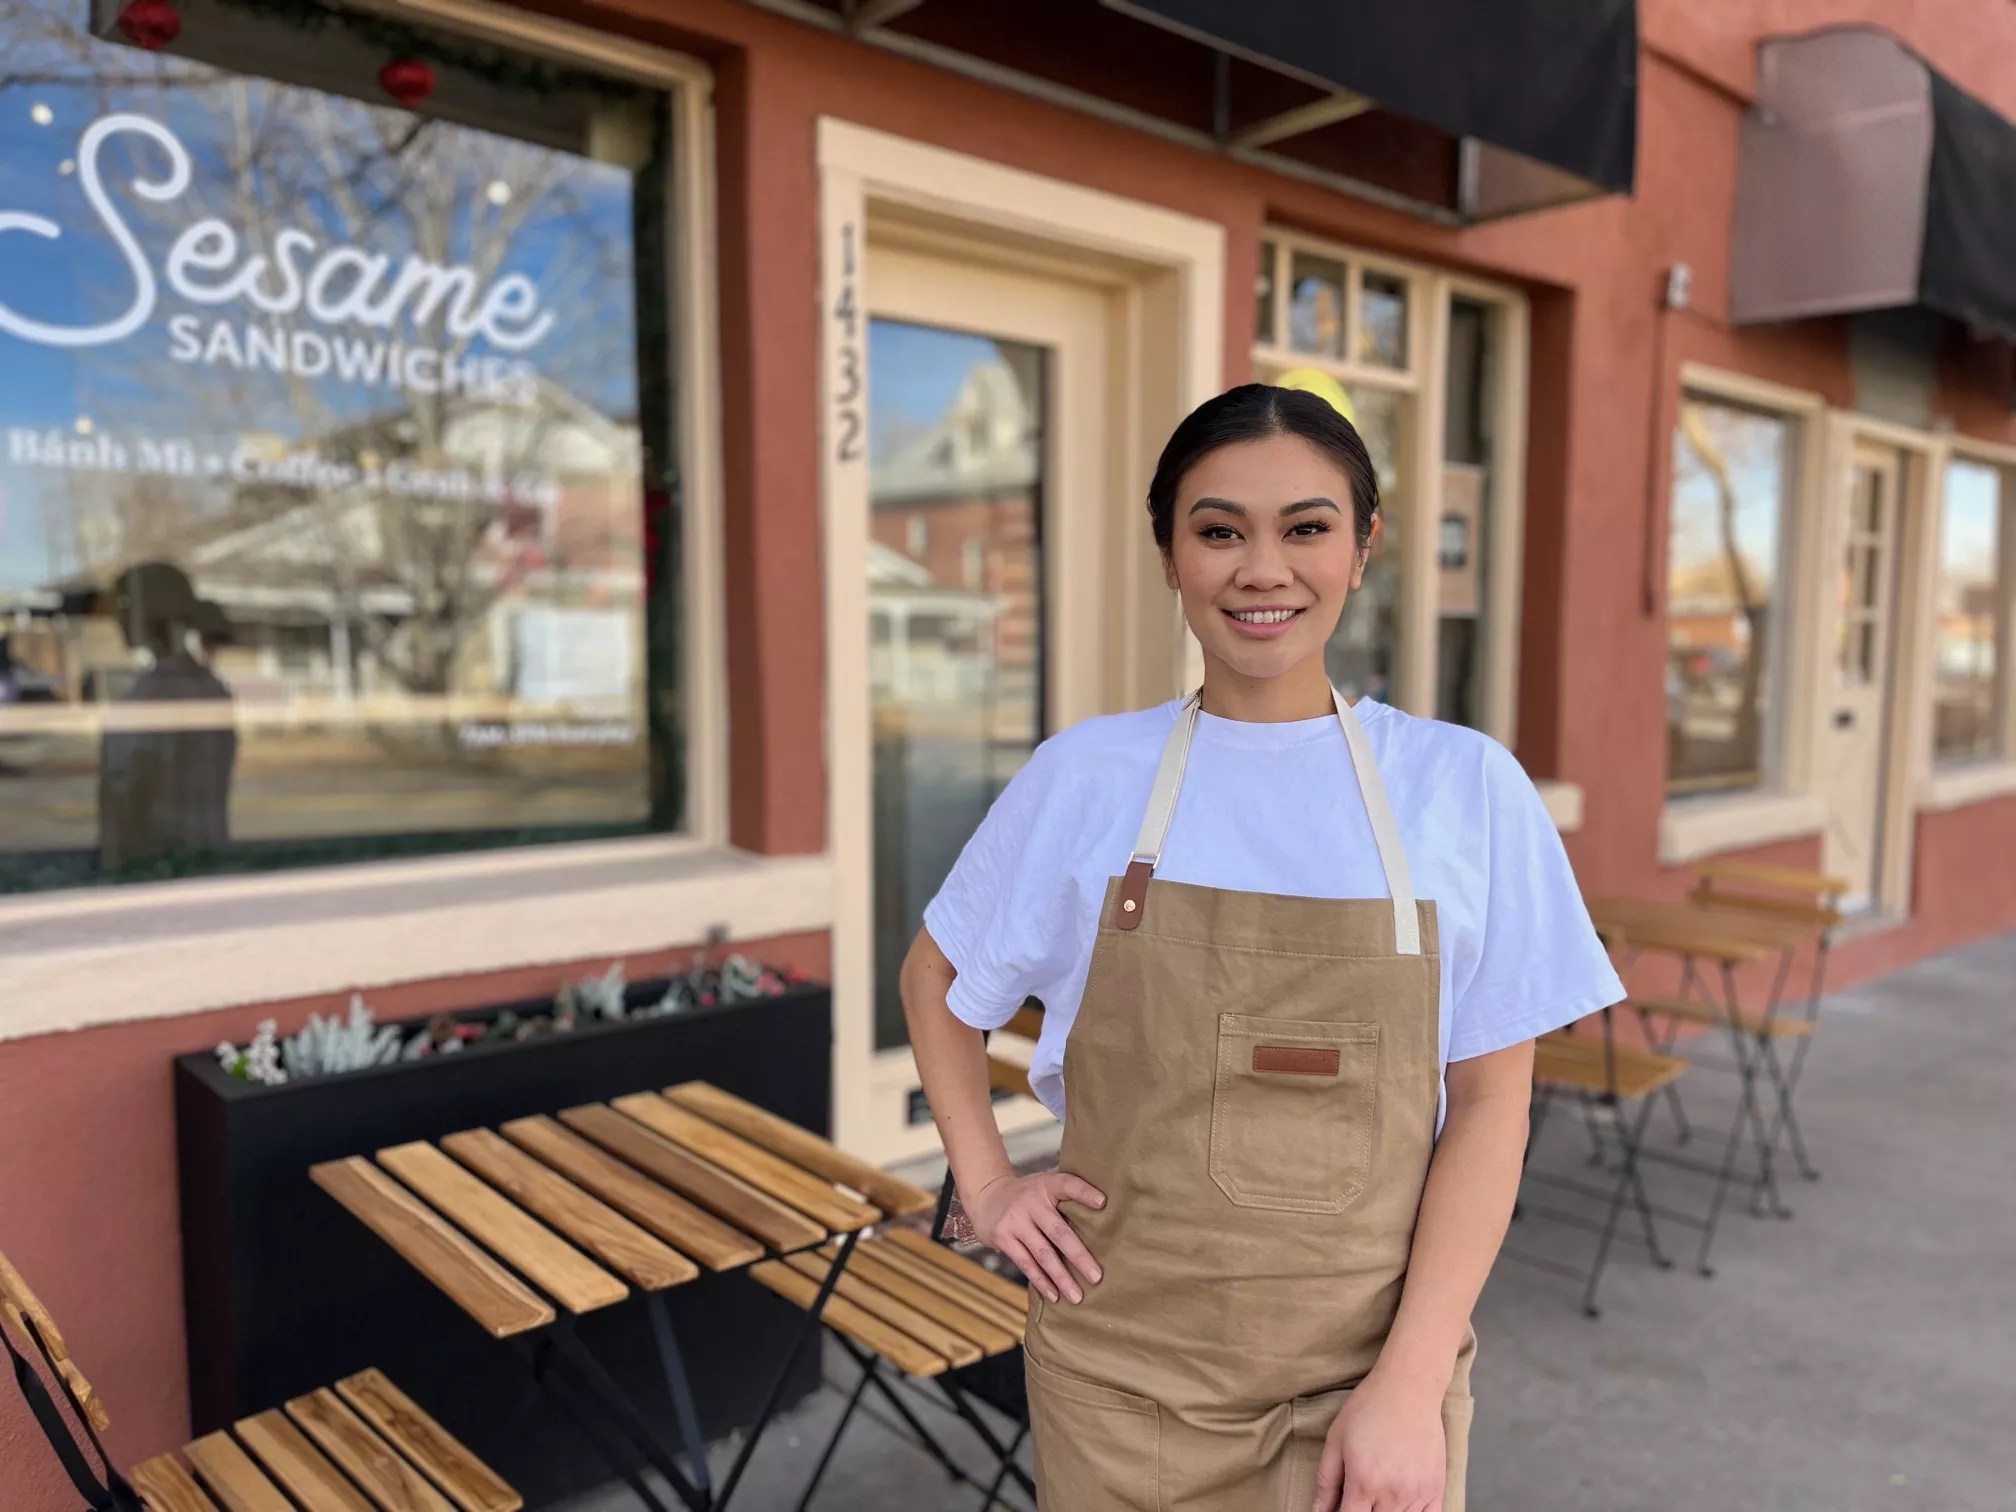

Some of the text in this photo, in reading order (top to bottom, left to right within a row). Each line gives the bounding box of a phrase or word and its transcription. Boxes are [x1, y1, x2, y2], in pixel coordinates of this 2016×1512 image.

[0, 112, 556, 349] Sesame
[835, 222, 862, 463] 1432
[168, 313, 539, 407] SANDWICHES
